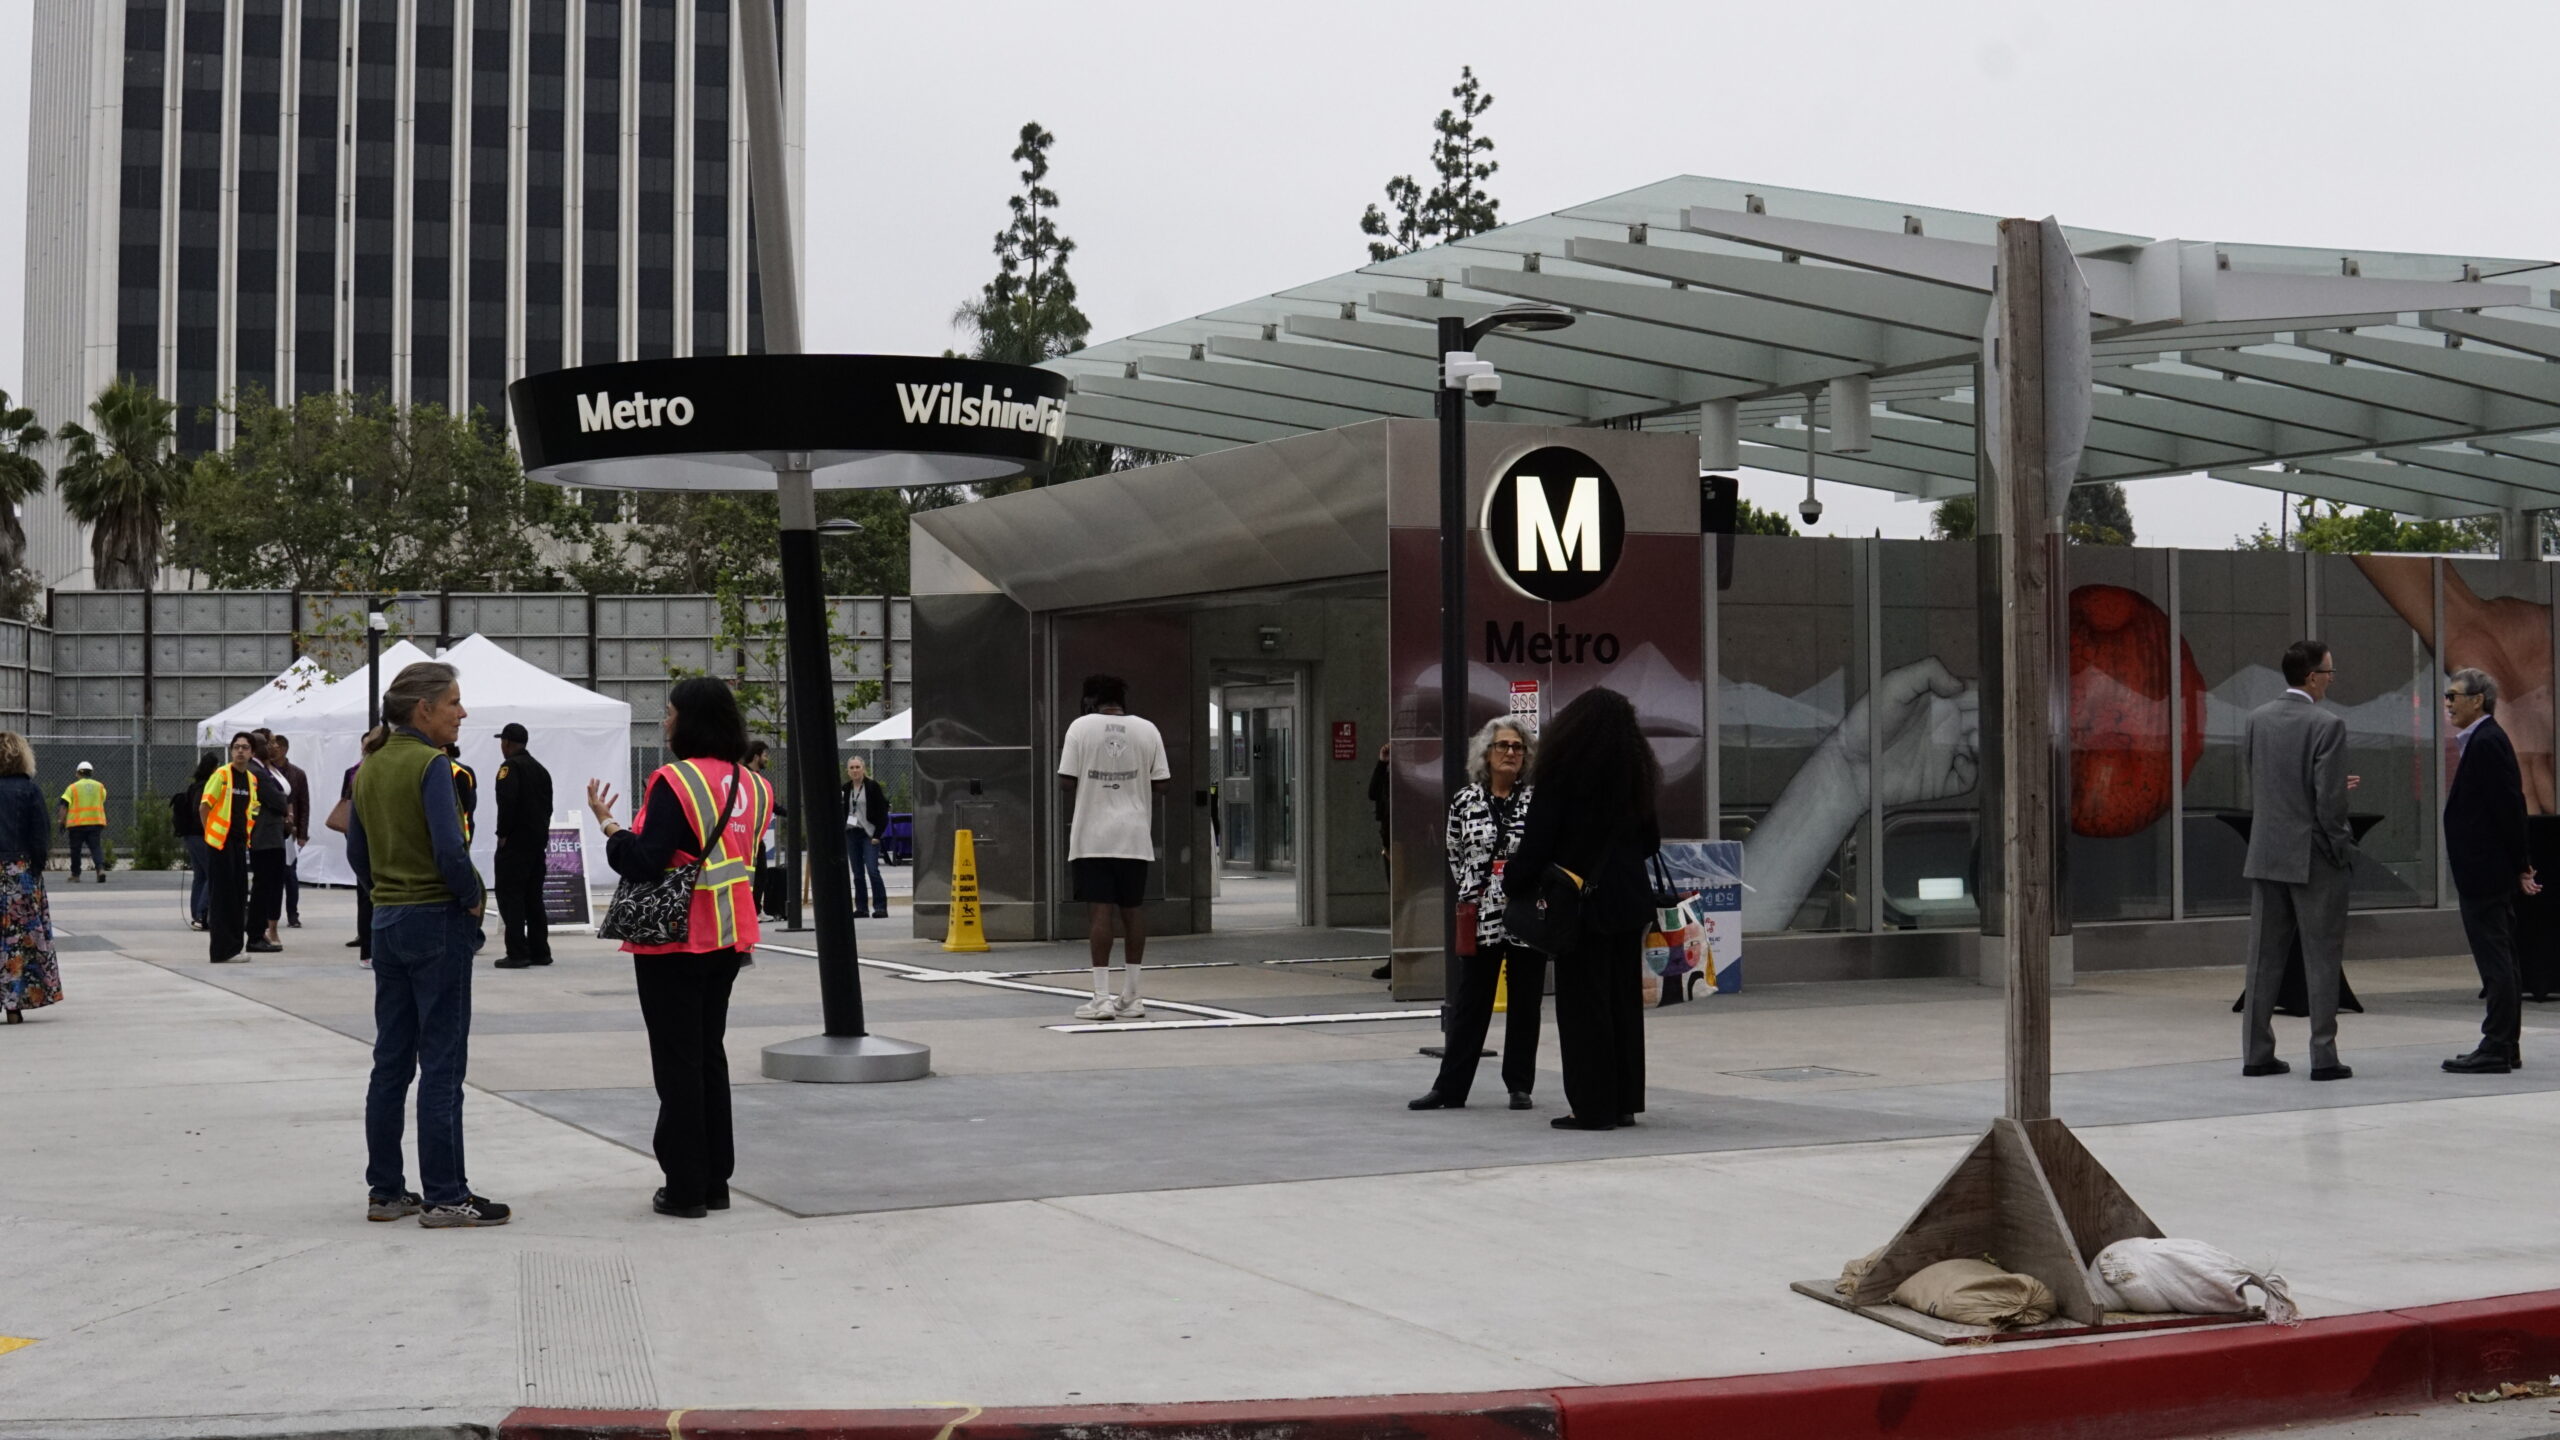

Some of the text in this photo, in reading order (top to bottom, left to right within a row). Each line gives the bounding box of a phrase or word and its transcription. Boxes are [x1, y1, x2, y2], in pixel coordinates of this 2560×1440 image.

[576, 391, 694, 433] Metro
[1516, 475, 1601, 572] M
[1485, 620, 1620, 664] Metro
[550, 841, 581, 853] DEEP
